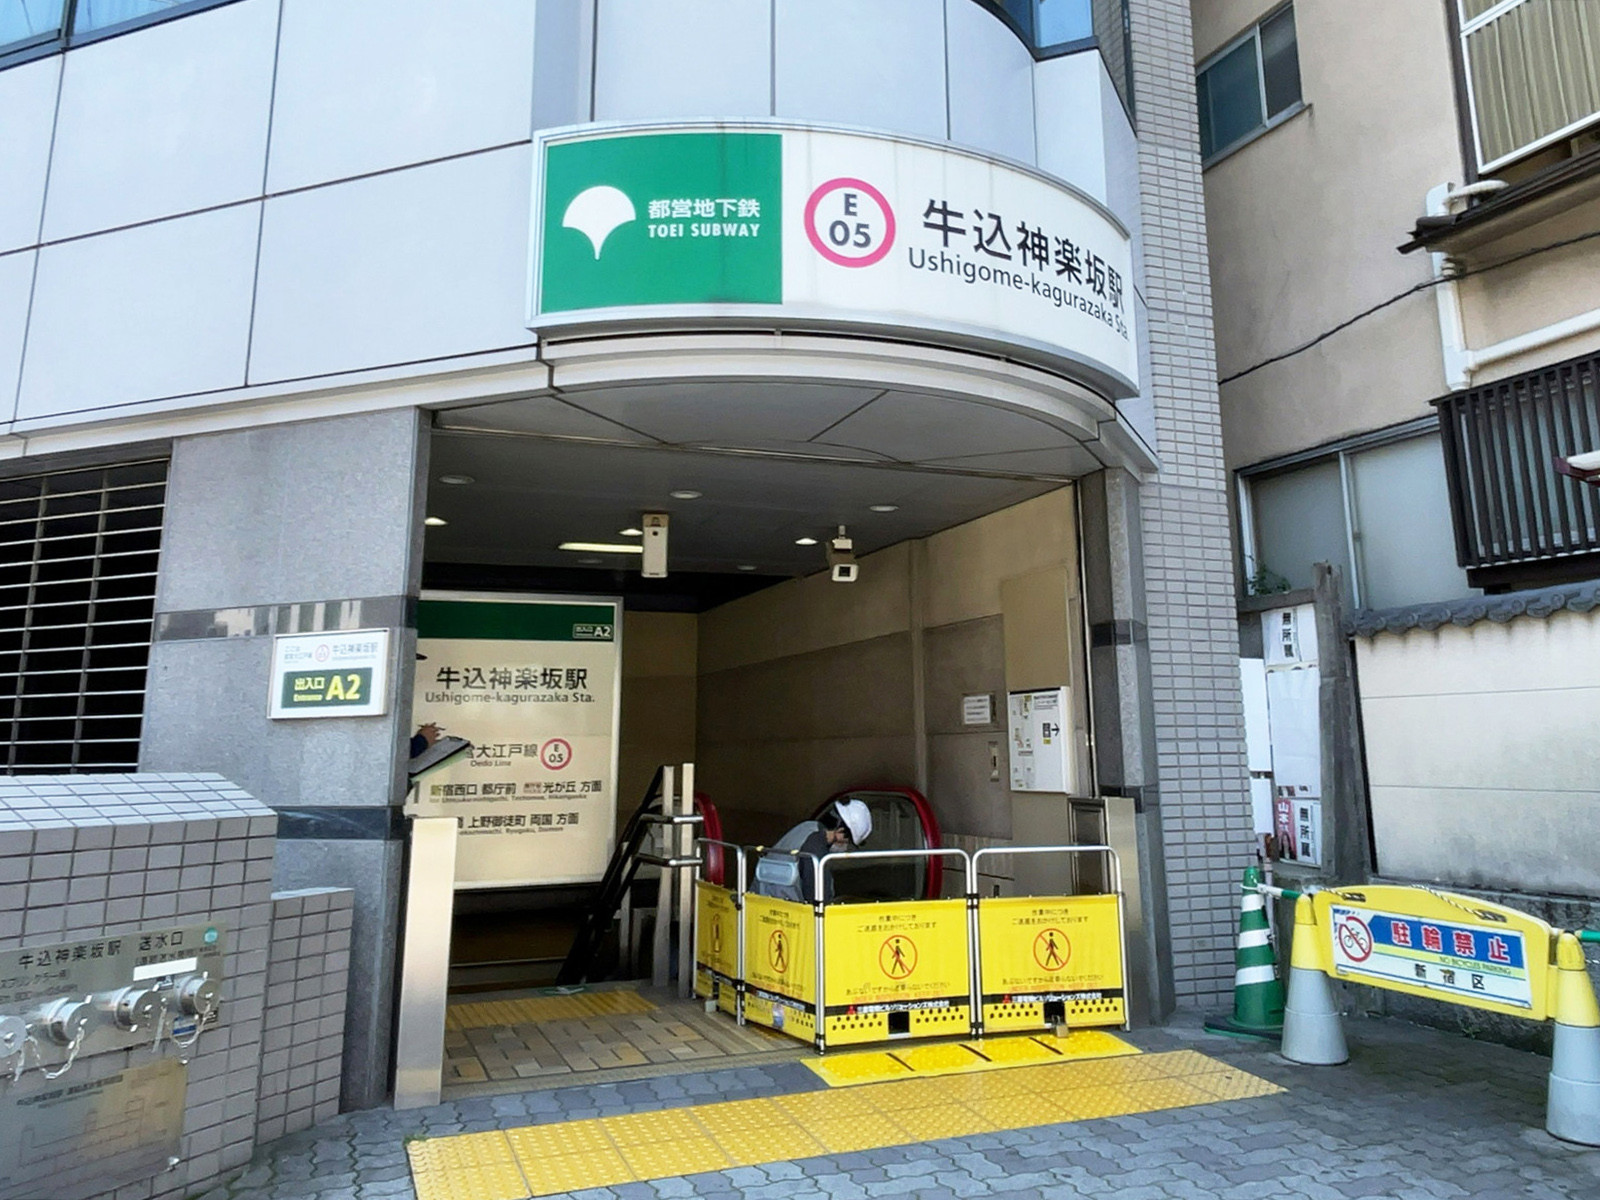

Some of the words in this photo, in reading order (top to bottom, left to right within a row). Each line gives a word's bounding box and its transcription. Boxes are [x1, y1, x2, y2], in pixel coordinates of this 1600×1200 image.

[648, 198, 760, 219] 都営地下鉄
[844, 193, 857, 216] E
[648, 224, 684, 238] TOEI
[691, 223, 760, 237] SUBWAY
[829, 220, 871, 248] 05
[923, 199, 1125, 314] 牛込神楽坂駅
[909, 247, 1113, 328] Ushigome-kagurazaka
[594, 626, 610, 637] A2
[294, 677, 325, 691] 出入口
[325, 674, 361, 701] A2
[437, 667, 588, 690] 牛込神楽坂駅
[425, 692, 569, 705] Ushigome-kagurazaka
[573, 692, 595, 703] Sta.
[543, 781, 576, 793] 光が丘
[580, 780, 602, 792] 方面
[556, 812, 579, 825] 方面
[1391, 921, 1510, 963] 駐輪禁止
[1415, 963, 1485, 990] 新宿区
